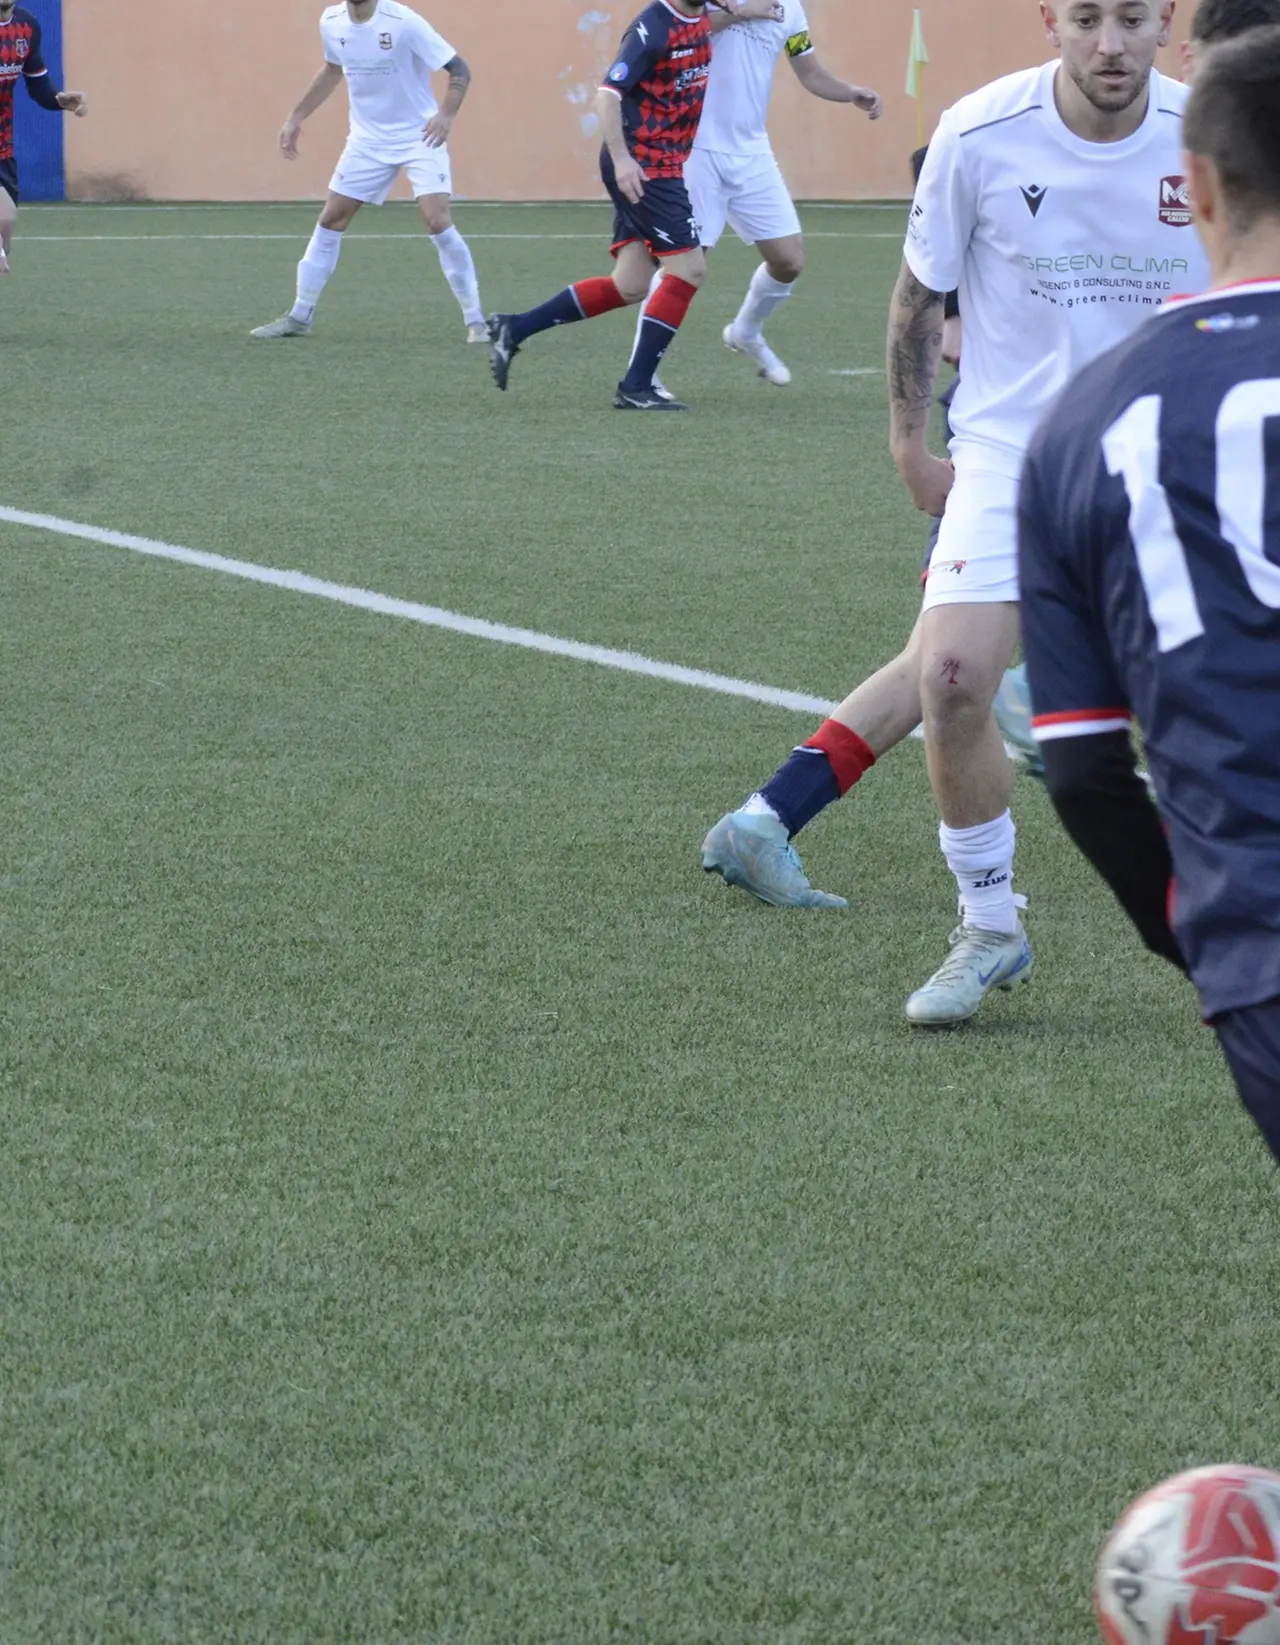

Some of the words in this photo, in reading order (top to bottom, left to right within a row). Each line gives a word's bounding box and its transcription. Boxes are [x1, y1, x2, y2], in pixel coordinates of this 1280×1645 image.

[1021, 255, 1102, 273] GREEN
[1111, 255, 1188, 273] CLIMA
[1082, 277, 1143, 289] CONSULTING
[971, 873, 1008, 889] ZEUS
